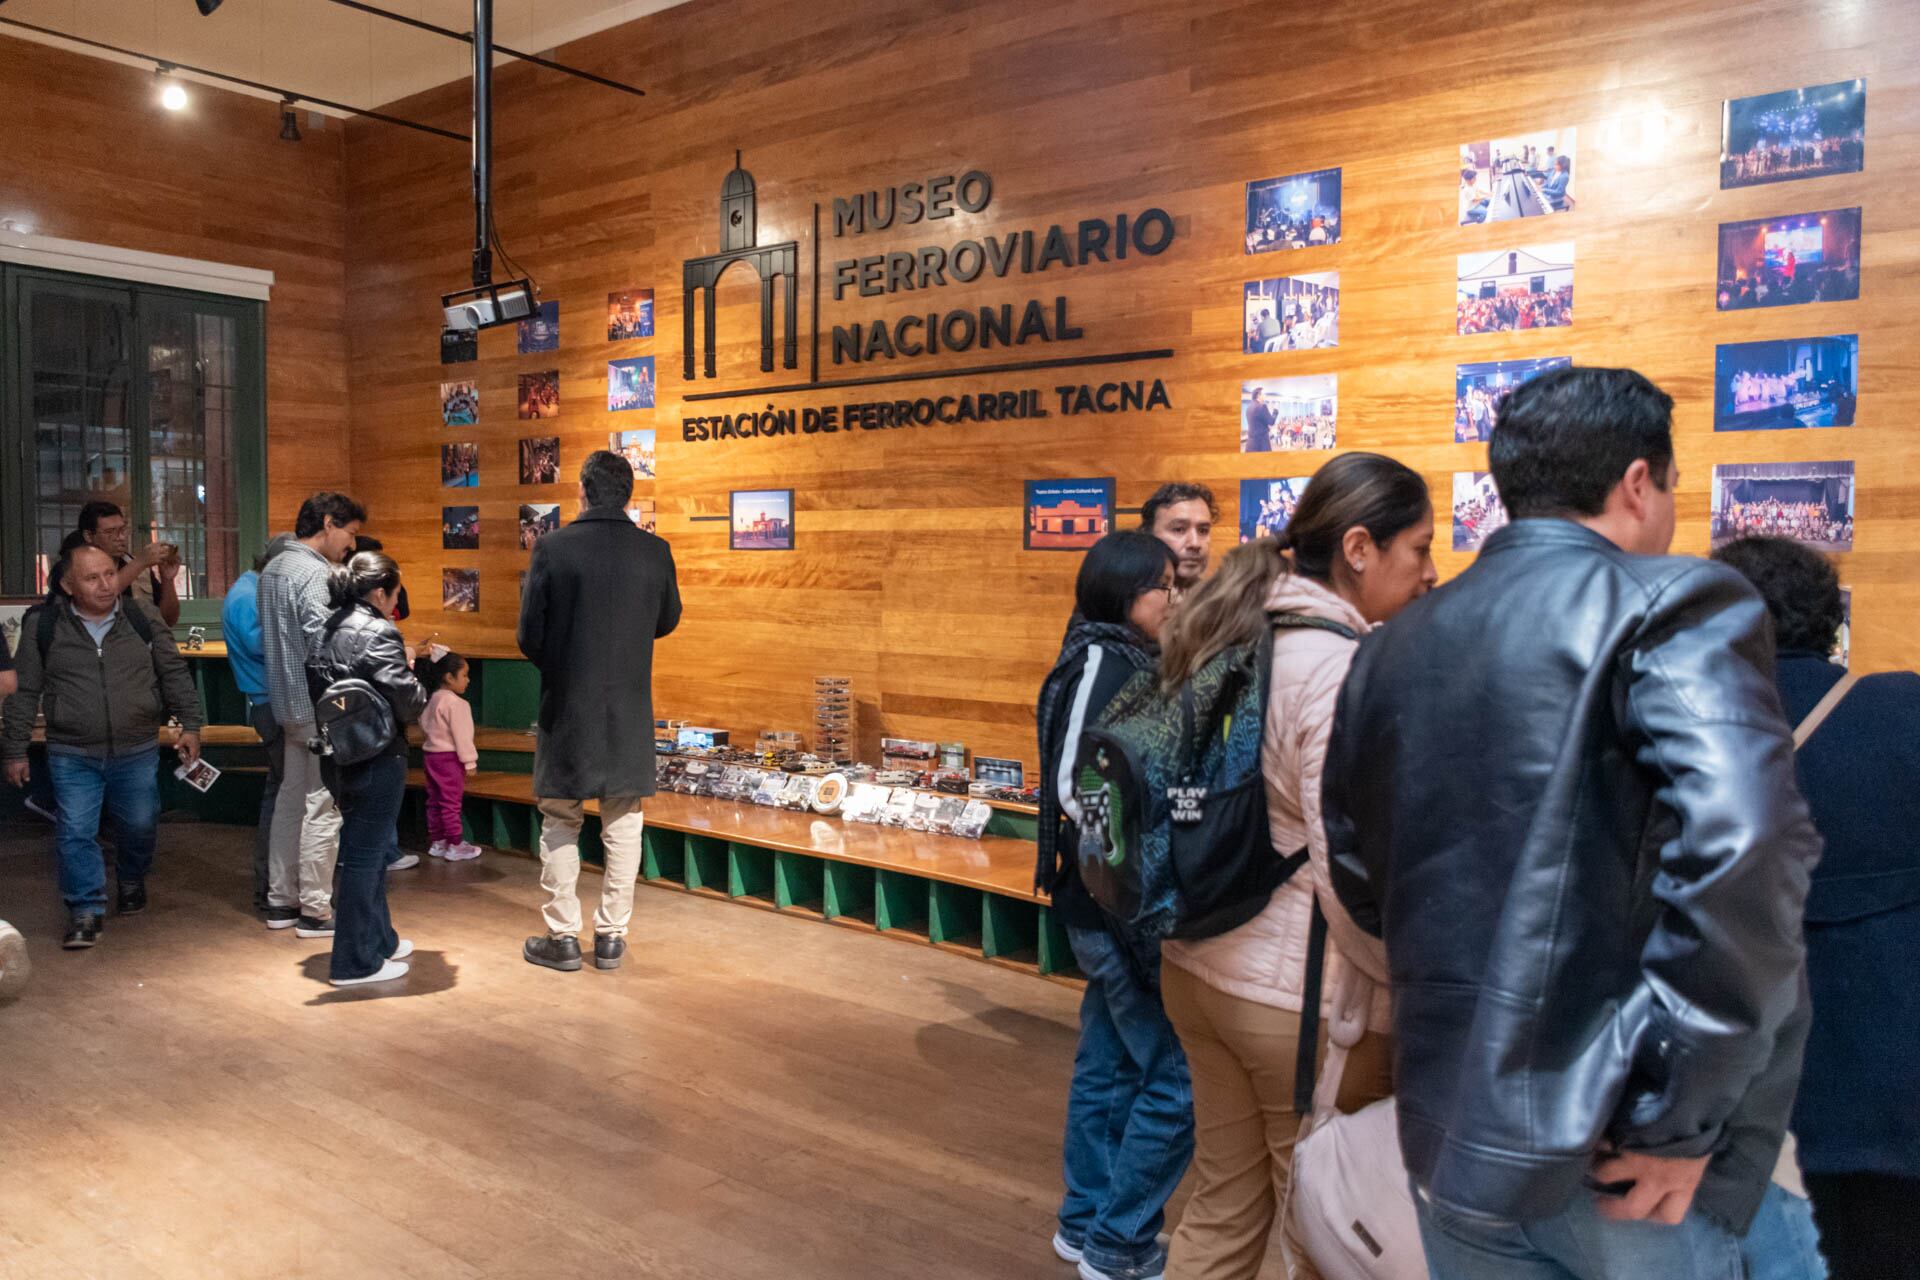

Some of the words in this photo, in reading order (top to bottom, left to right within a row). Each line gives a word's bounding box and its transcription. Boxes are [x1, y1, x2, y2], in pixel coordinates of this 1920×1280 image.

[832, 170, 992, 237] MUSEO
[832, 207, 1175, 300] FERROVIARIO
[832, 296, 1084, 365] NACIONAL
[682, 403, 796, 442] ESTACIÓN
[802, 405, 838, 434] DE
[843, 388, 1048, 431] FERROCARRIL
[1055, 378, 1173, 416] TACNA
[1167, 787, 1207, 799] PLAY
[1171, 809, 1203, 821] WIN
[1175, 798, 1198, 809] TO
